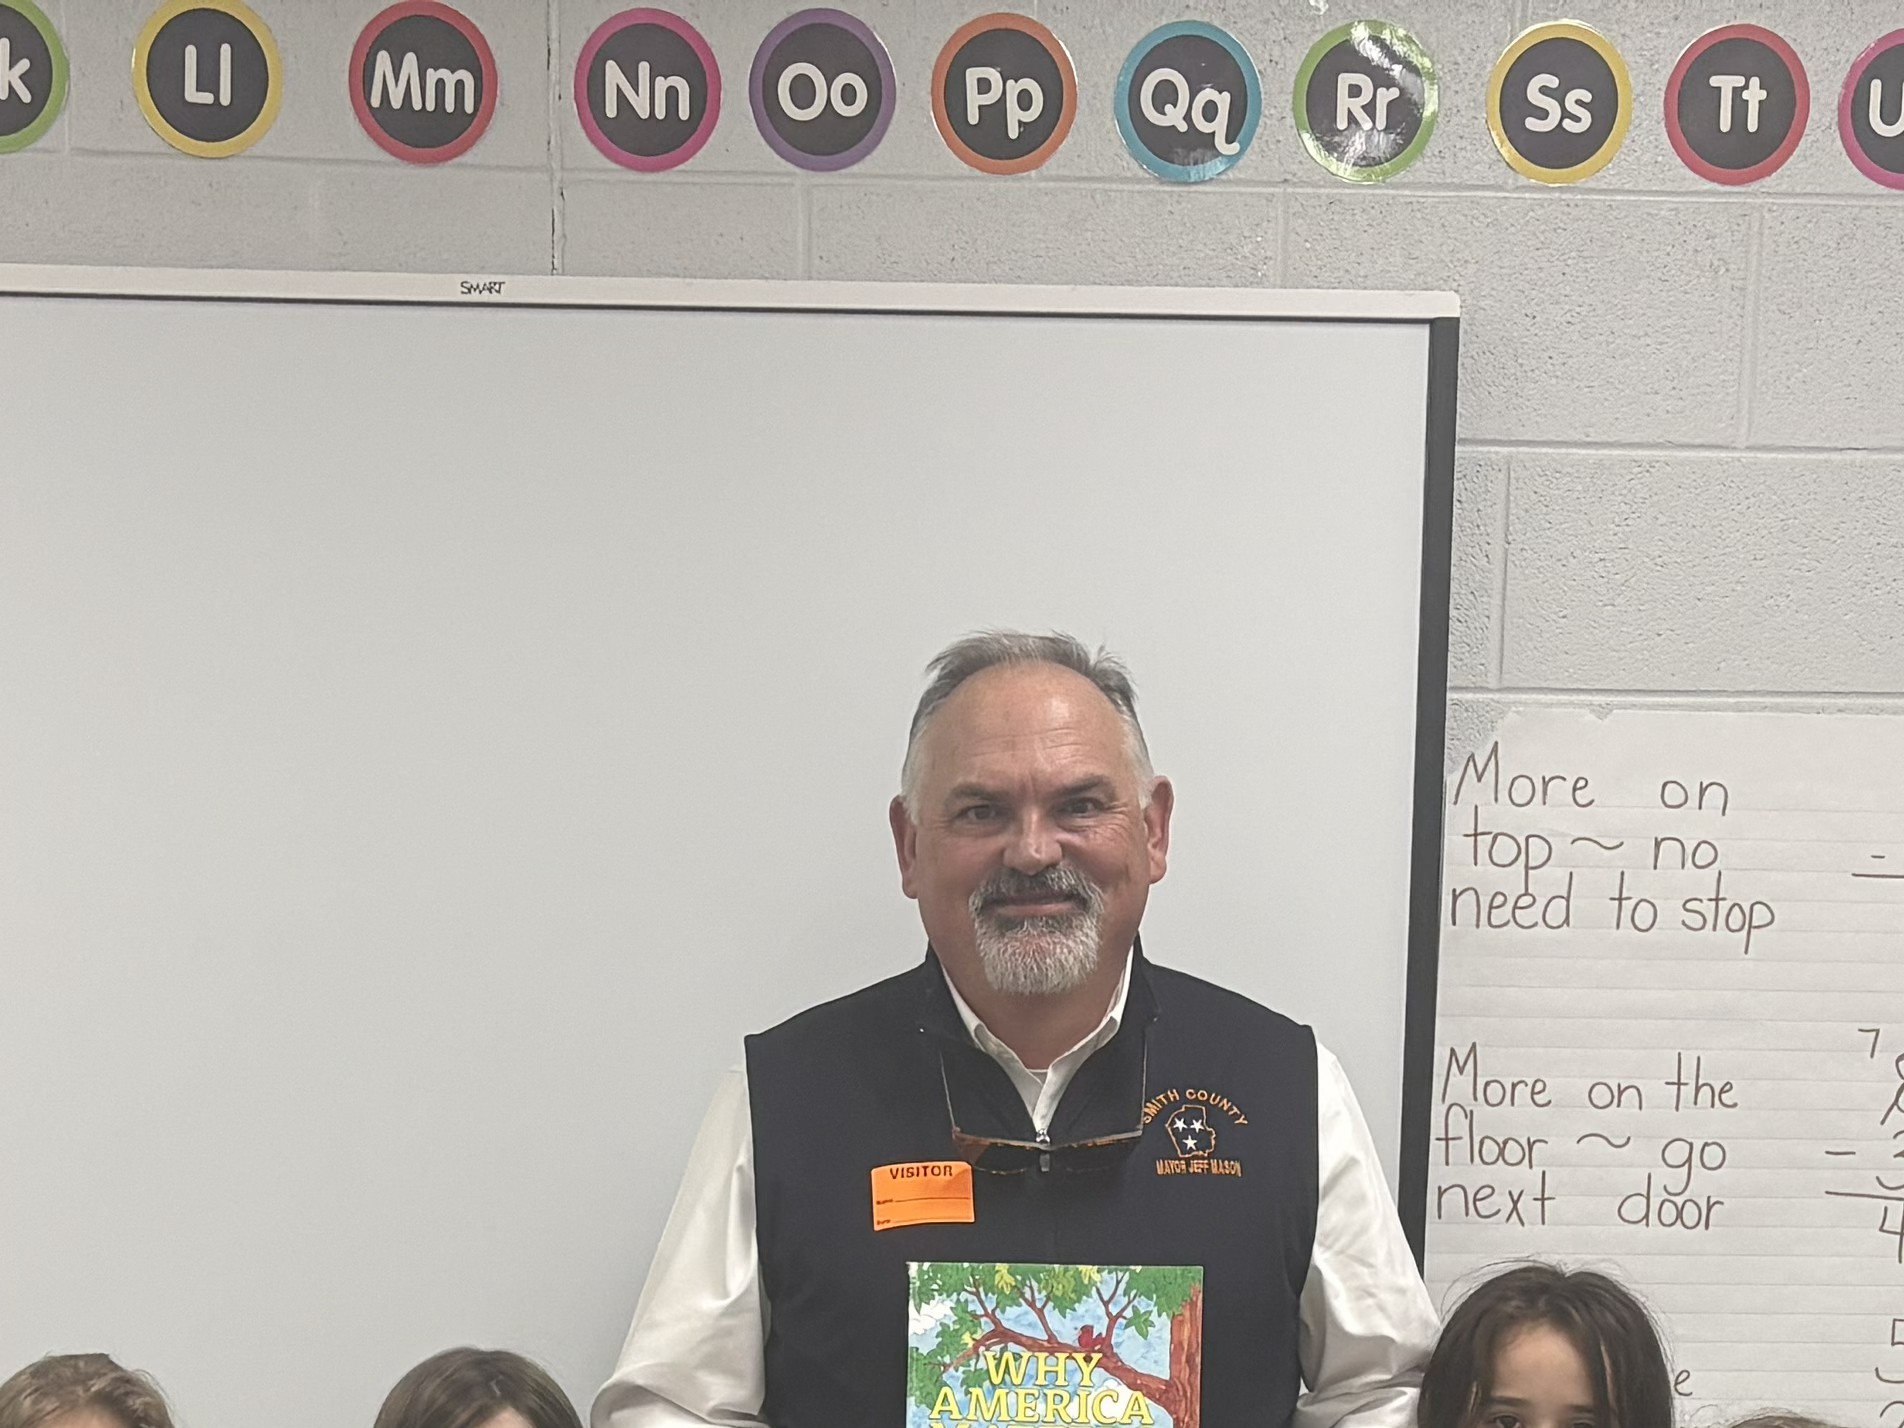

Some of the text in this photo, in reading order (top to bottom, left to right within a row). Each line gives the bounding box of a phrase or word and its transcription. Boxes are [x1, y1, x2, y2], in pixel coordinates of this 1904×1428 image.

[369, 50, 473, 115] Mm
[605, 60, 689, 122] Nn
[778, 62, 867, 121] Oo
[966, 68, 1042, 138] Pp
[1336, 74, 1397, 131] Rr
[1525, 75, 1593, 134] Ss
[1710, 75, 1768, 134] Tt
[1141, 69, 1240, 156] Qq
[459, 280, 507, 296] SMART
[1454, 742, 1728, 816] More on
[1463, 806, 1718, 893] top no
[1451, 872, 1775, 954] need to stop
[1442, 1042, 1739, 1110] More on the
[1143, 1089, 1248, 1125] SMITH COUNTY
[889, 1165, 953, 1180] VISITOR
[1156, 1159, 1242, 1177] MAYOR JEFF MASON
[1436, 1103, 1727, 1194] floor go
[1437, 1172, 1724, 1231] next door
[983, 1351, 1103, 1387] WHY
[928, 1386, 1155, 1425] AMERICA
